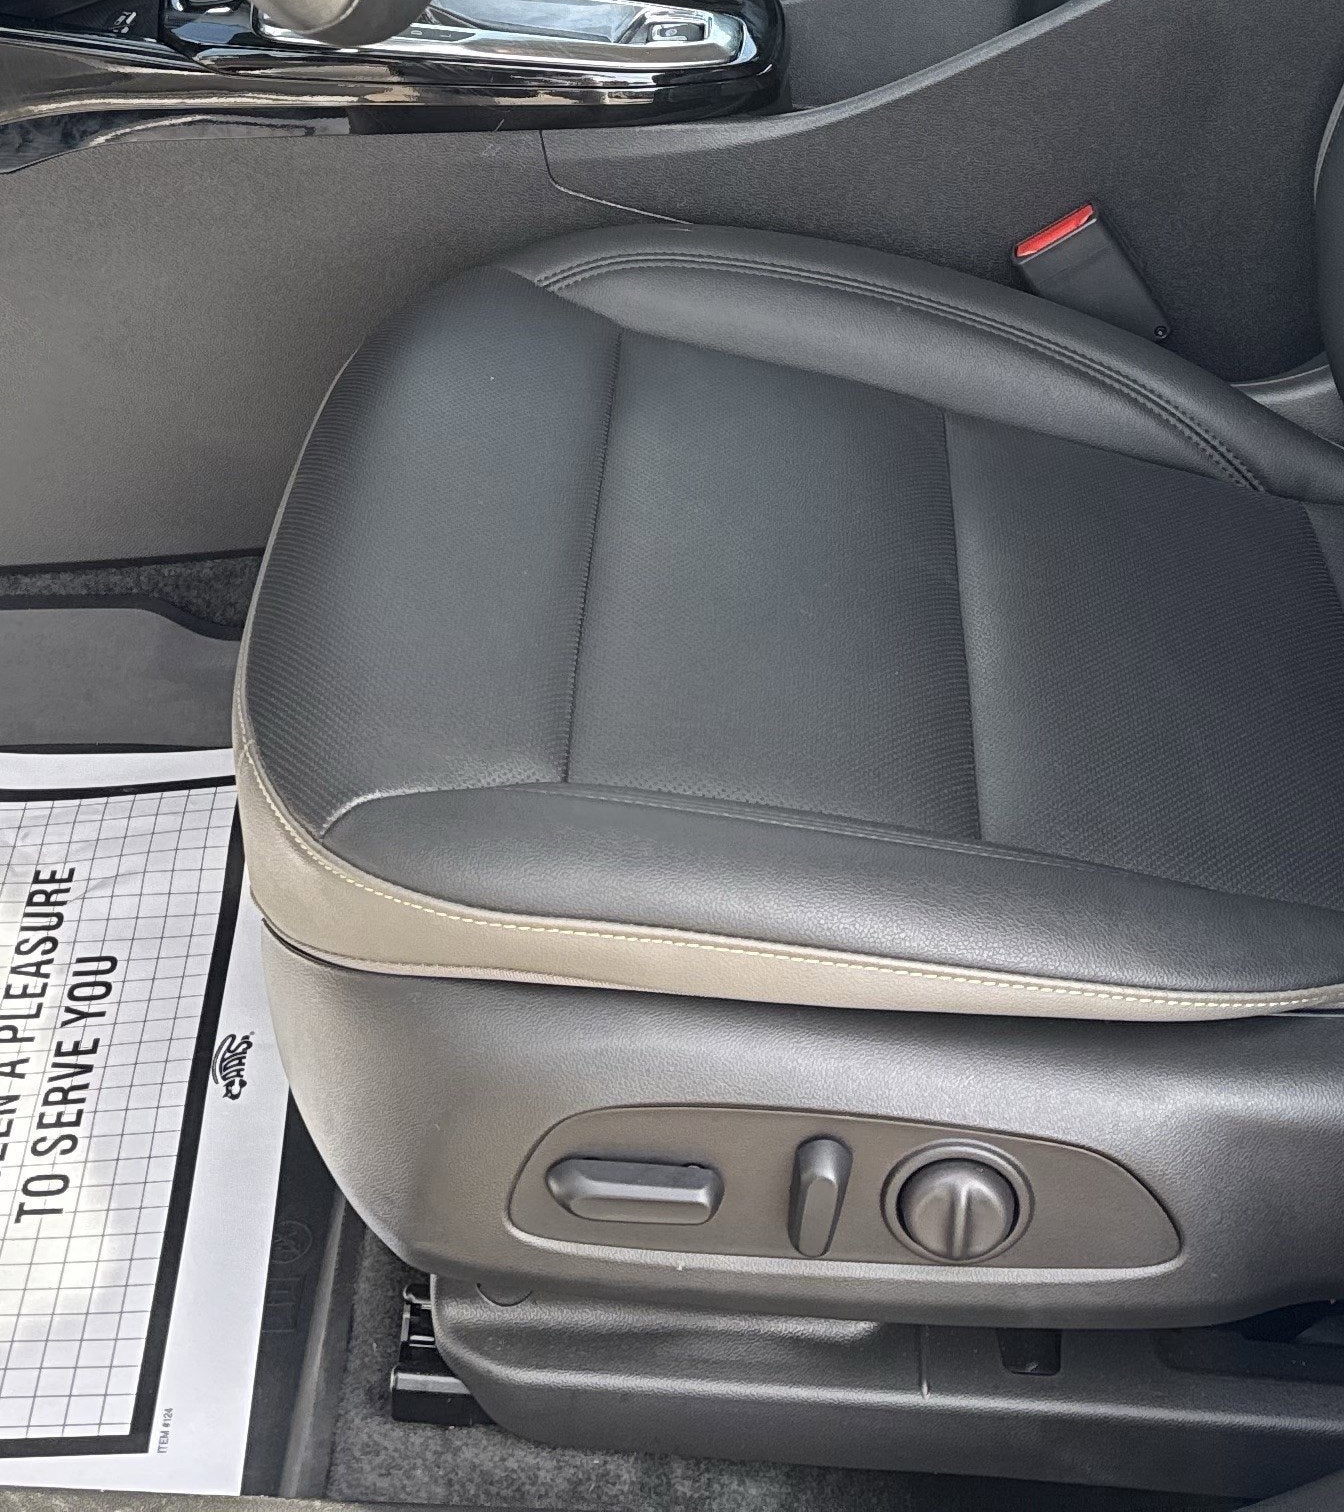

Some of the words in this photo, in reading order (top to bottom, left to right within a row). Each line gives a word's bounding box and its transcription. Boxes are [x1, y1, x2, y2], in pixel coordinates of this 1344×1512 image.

[59, 955, 119, 1028] YOU
[30, 1037, 101, 1157] SERVE
[14, 1173, 71, 1224] TO
[157, 1430, 170, 1454] ITEM
